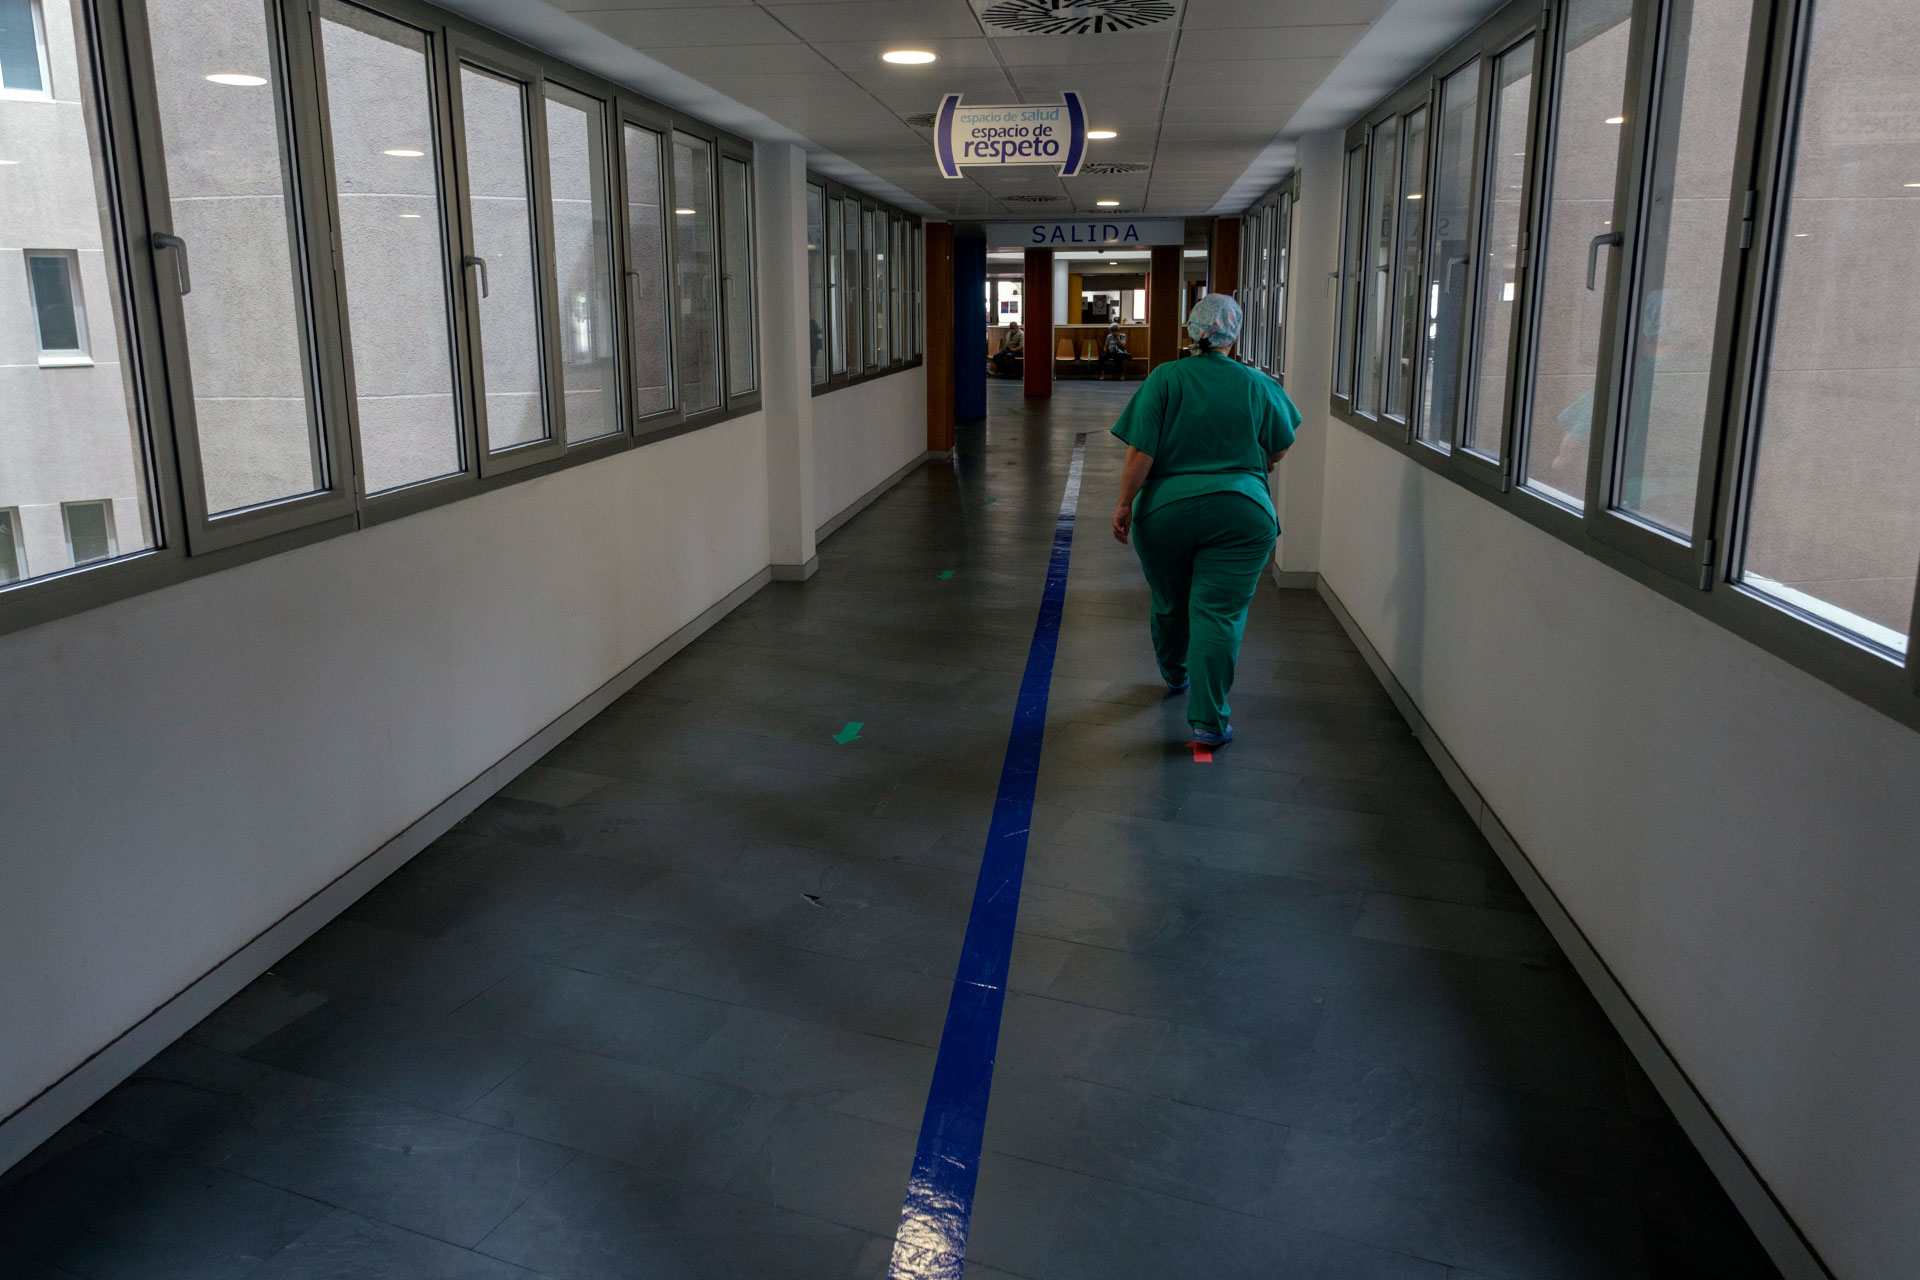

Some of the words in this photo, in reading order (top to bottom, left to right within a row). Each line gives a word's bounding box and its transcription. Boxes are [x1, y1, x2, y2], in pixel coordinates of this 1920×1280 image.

[960, 112, 1001, 125] espacio
[1003, 112, 1017, 122] de
[1021, 108, 1059, 121] salud
[971, 124, 1029, 141] espacio
[1032, 124, 1052, 137] de
[964, 137, 1060, 163] respeto
[1032, 224, 1140, 244] SALIDA
